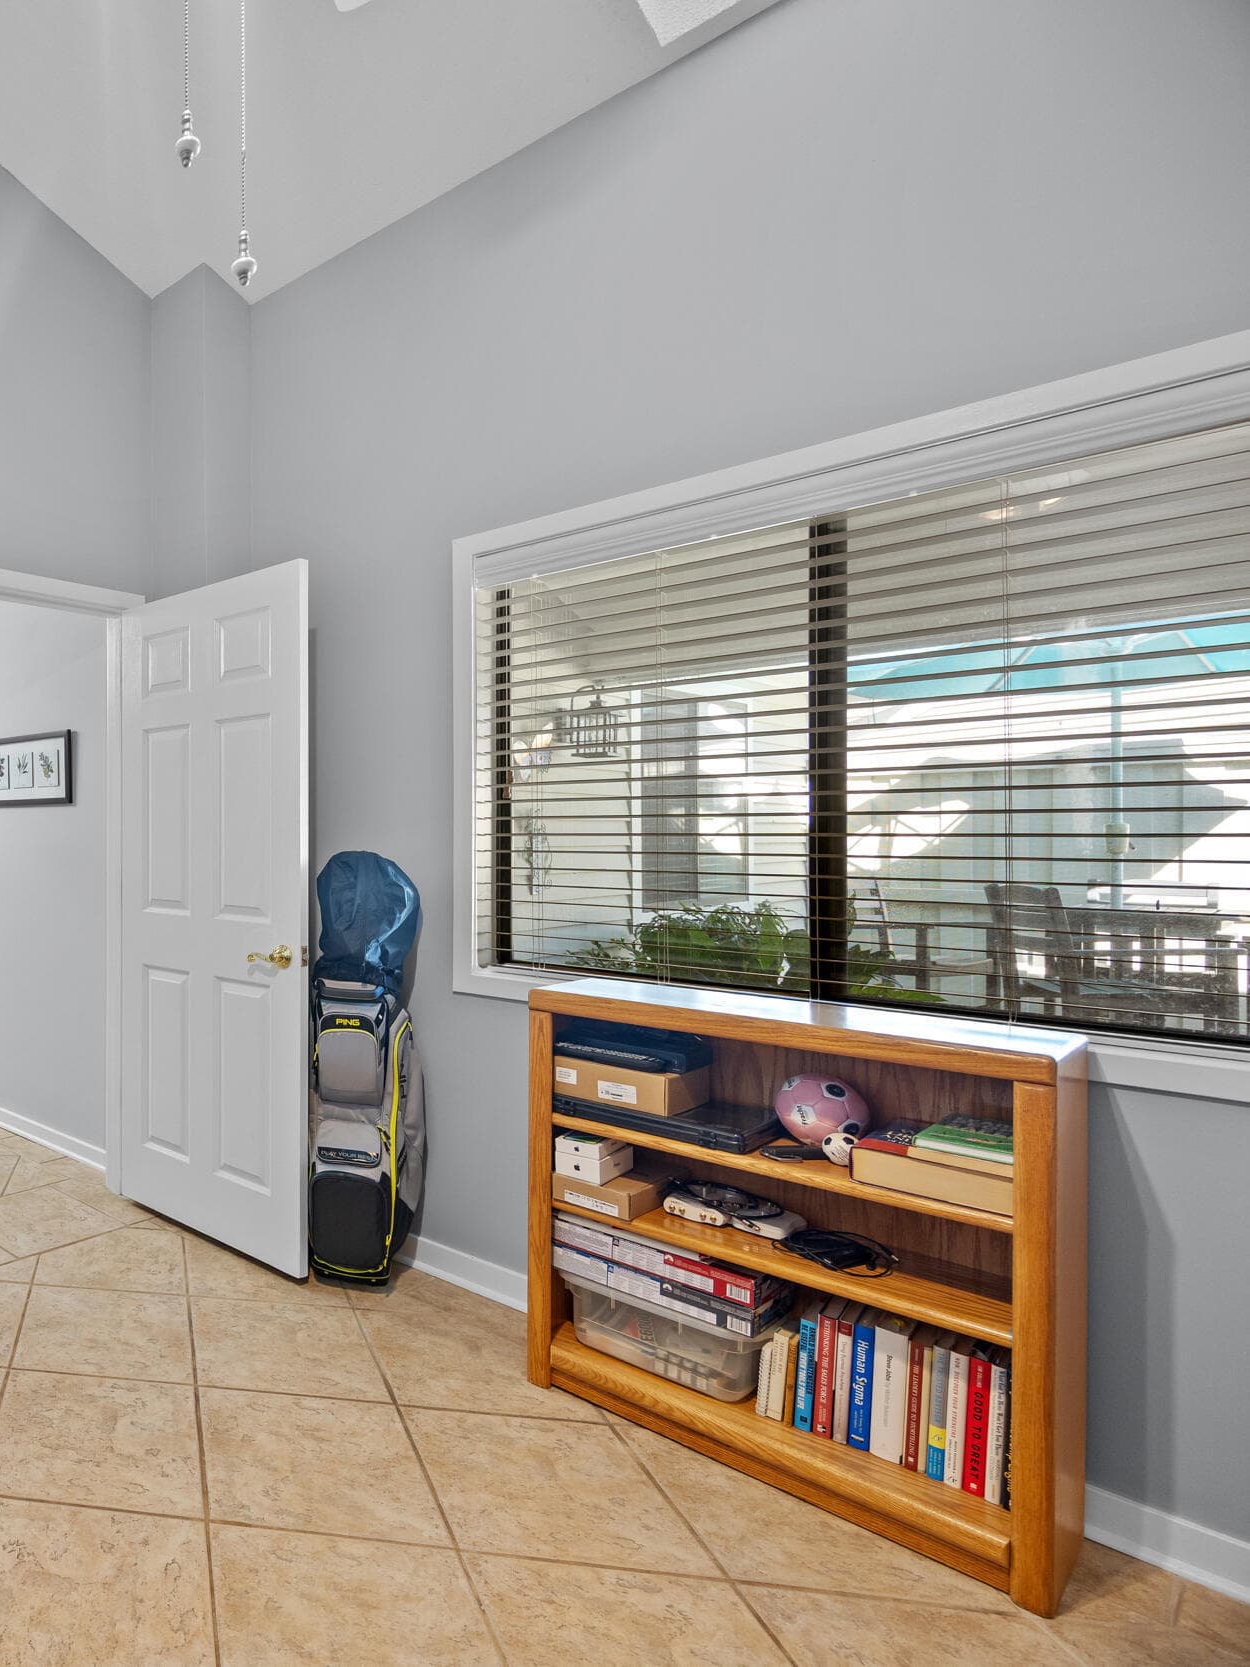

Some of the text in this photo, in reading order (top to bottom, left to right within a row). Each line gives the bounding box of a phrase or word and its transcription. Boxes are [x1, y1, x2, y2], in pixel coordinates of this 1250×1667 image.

[856, 1340, 869, 1373] Human
[853, 1375, 867, 1405] Sigma
[974, 1393, 983, 1421] GOOD
[974, 1426, 982, 1440] TO
[970, 1444, 981, 1480] GREAT
